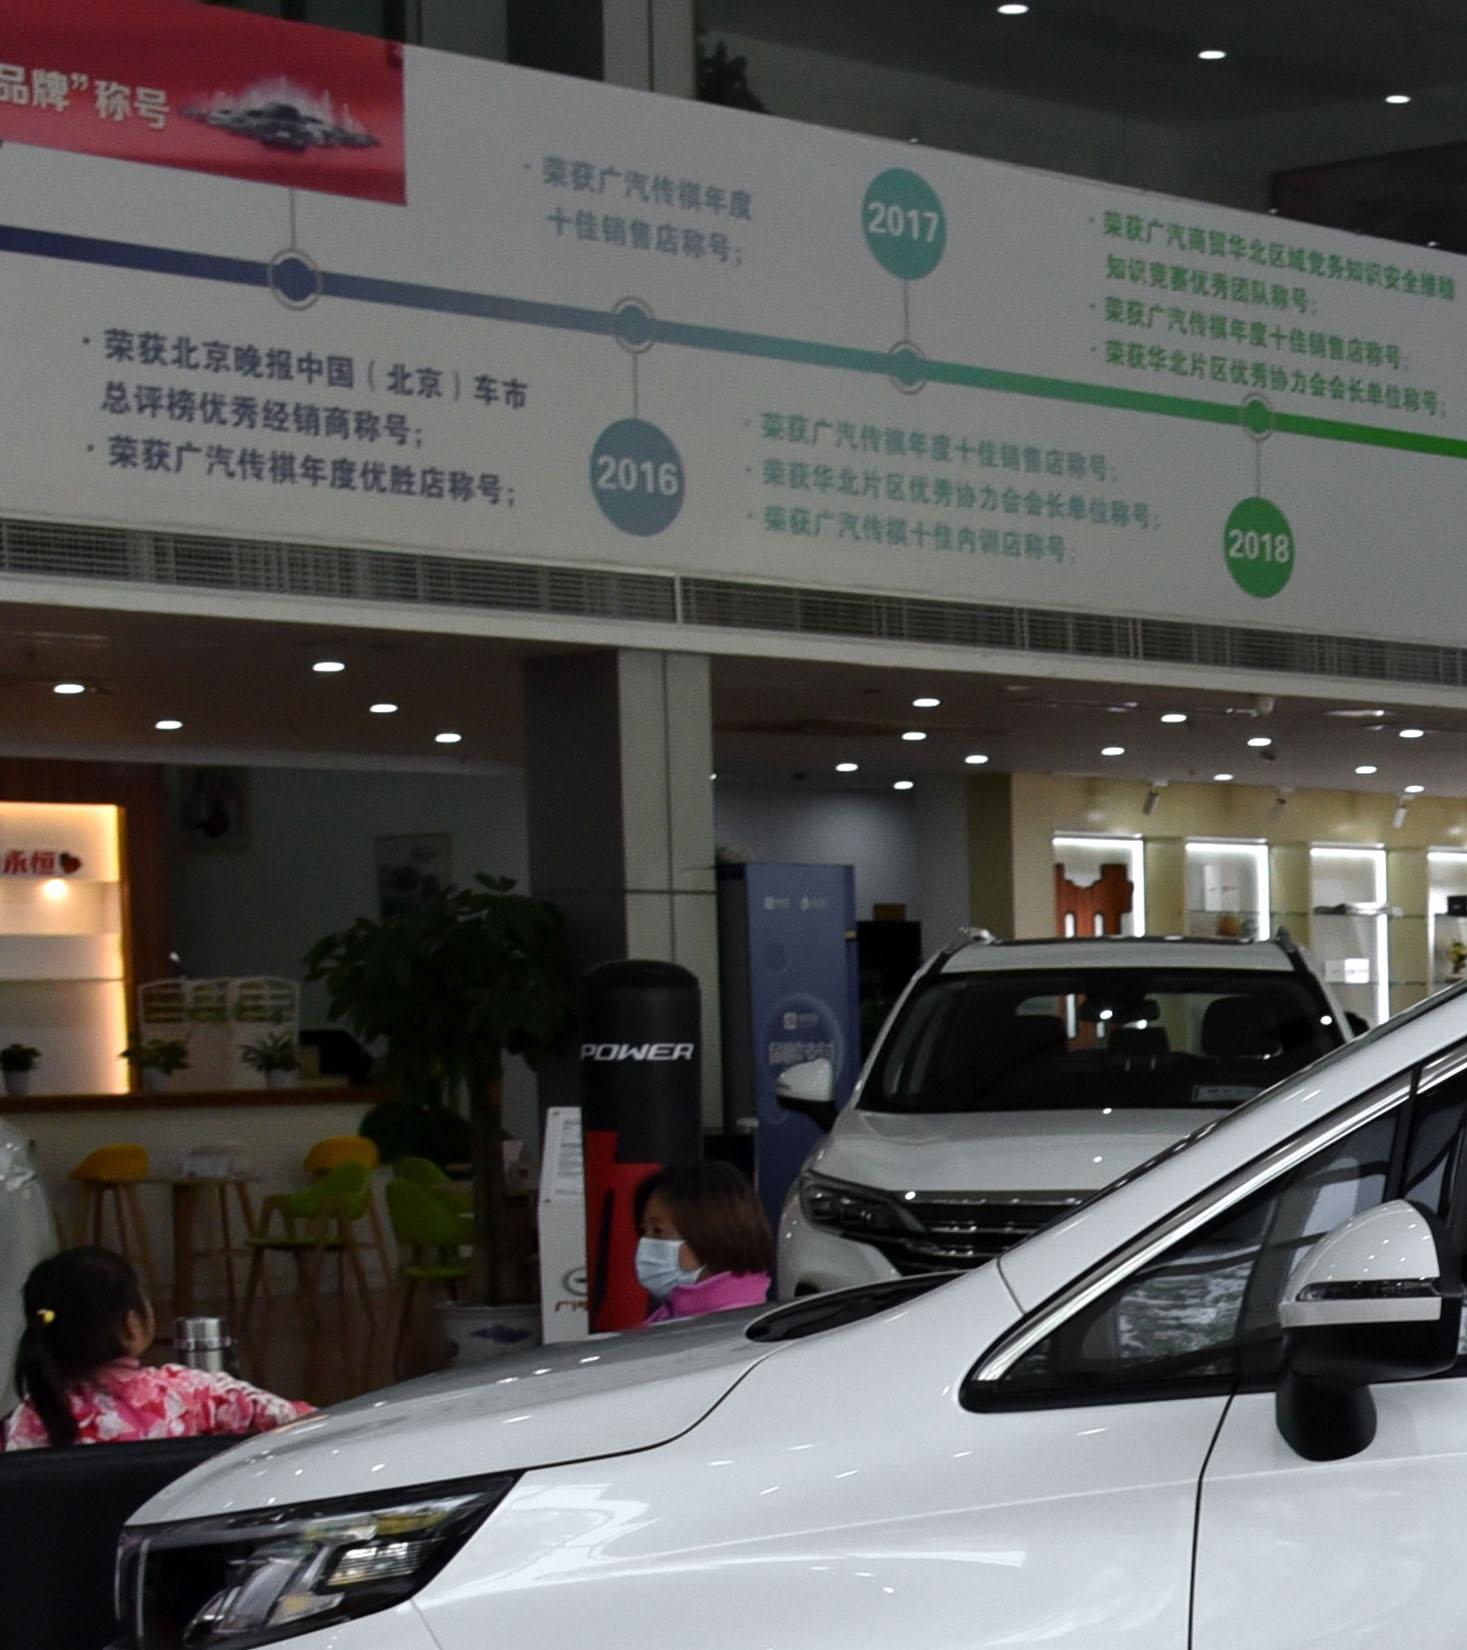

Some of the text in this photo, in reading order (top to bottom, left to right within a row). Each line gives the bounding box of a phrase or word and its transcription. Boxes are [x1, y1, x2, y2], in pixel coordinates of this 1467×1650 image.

[868, 200, 939, 244] 2017
[596, 455, 679, 496] 2016
[1228, 528, 1291, 563] 2018
[580, 1042, 695, 1062] POWER
